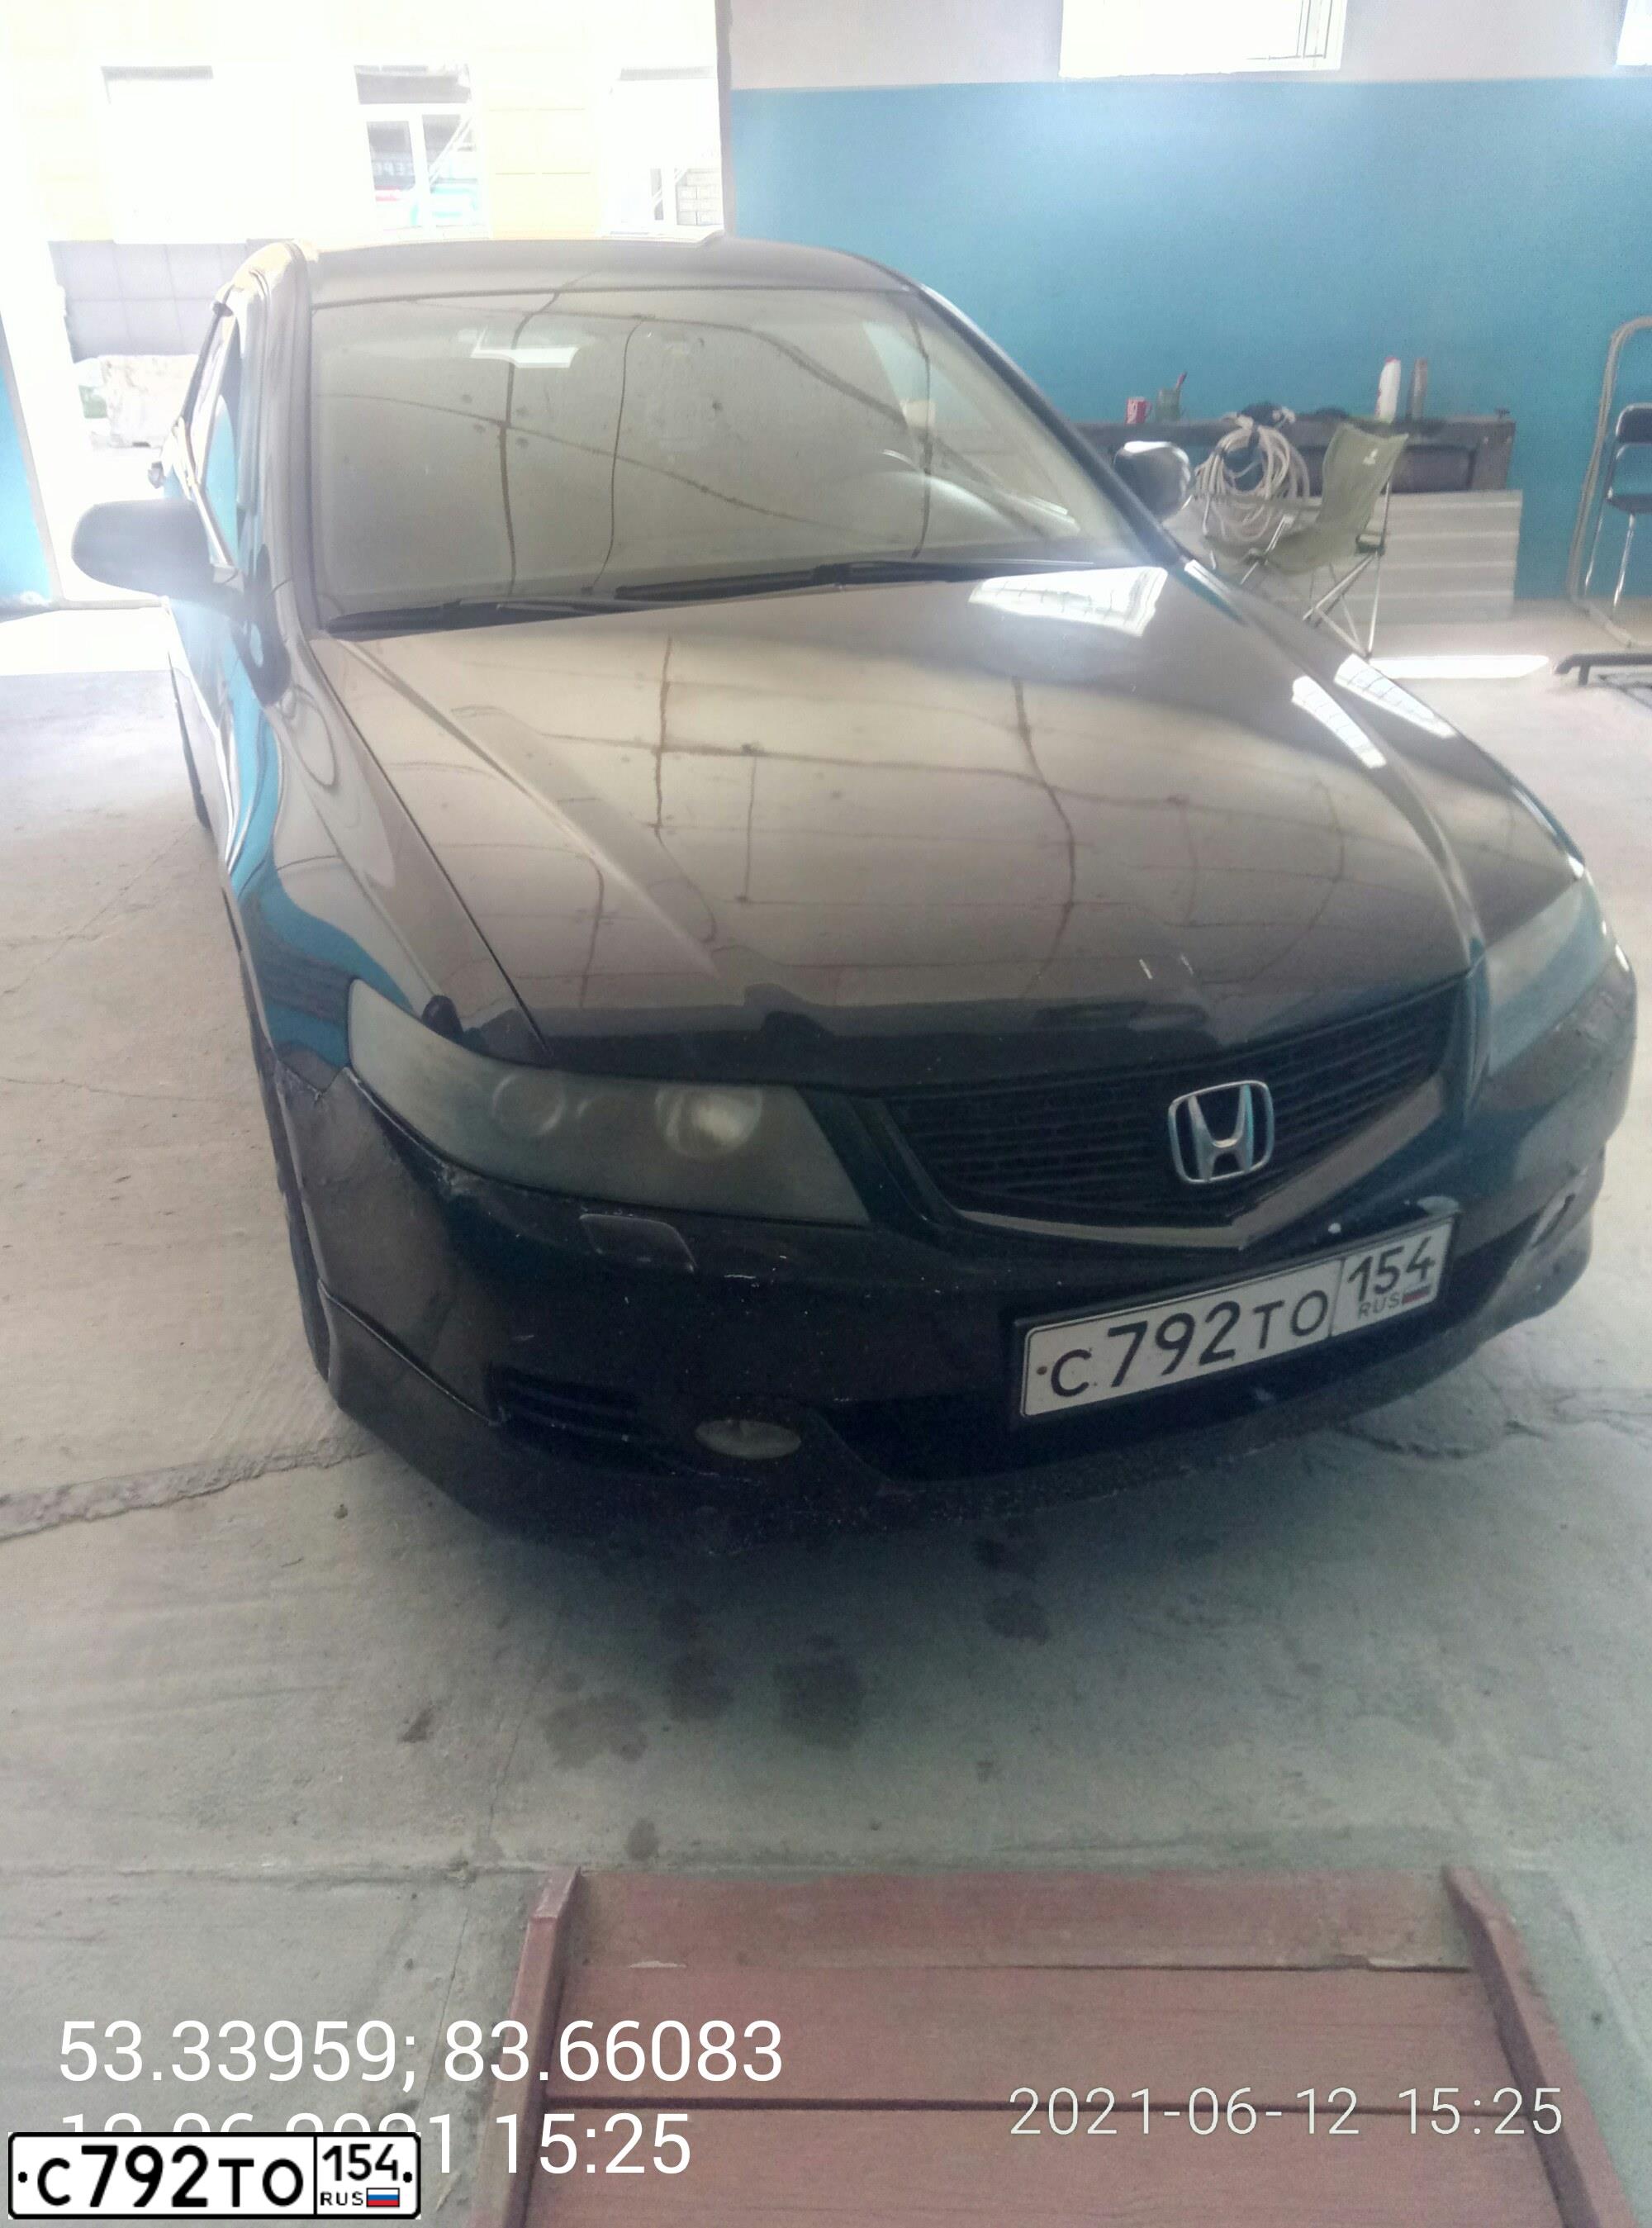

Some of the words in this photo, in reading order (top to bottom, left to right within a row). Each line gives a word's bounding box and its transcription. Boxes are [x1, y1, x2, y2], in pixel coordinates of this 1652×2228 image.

[1050, 1290, 1329, 1397] С792ТО
[1347, 1236, 1435, 1303] 154
[1358, 1292, 1400, 1320] RUS
